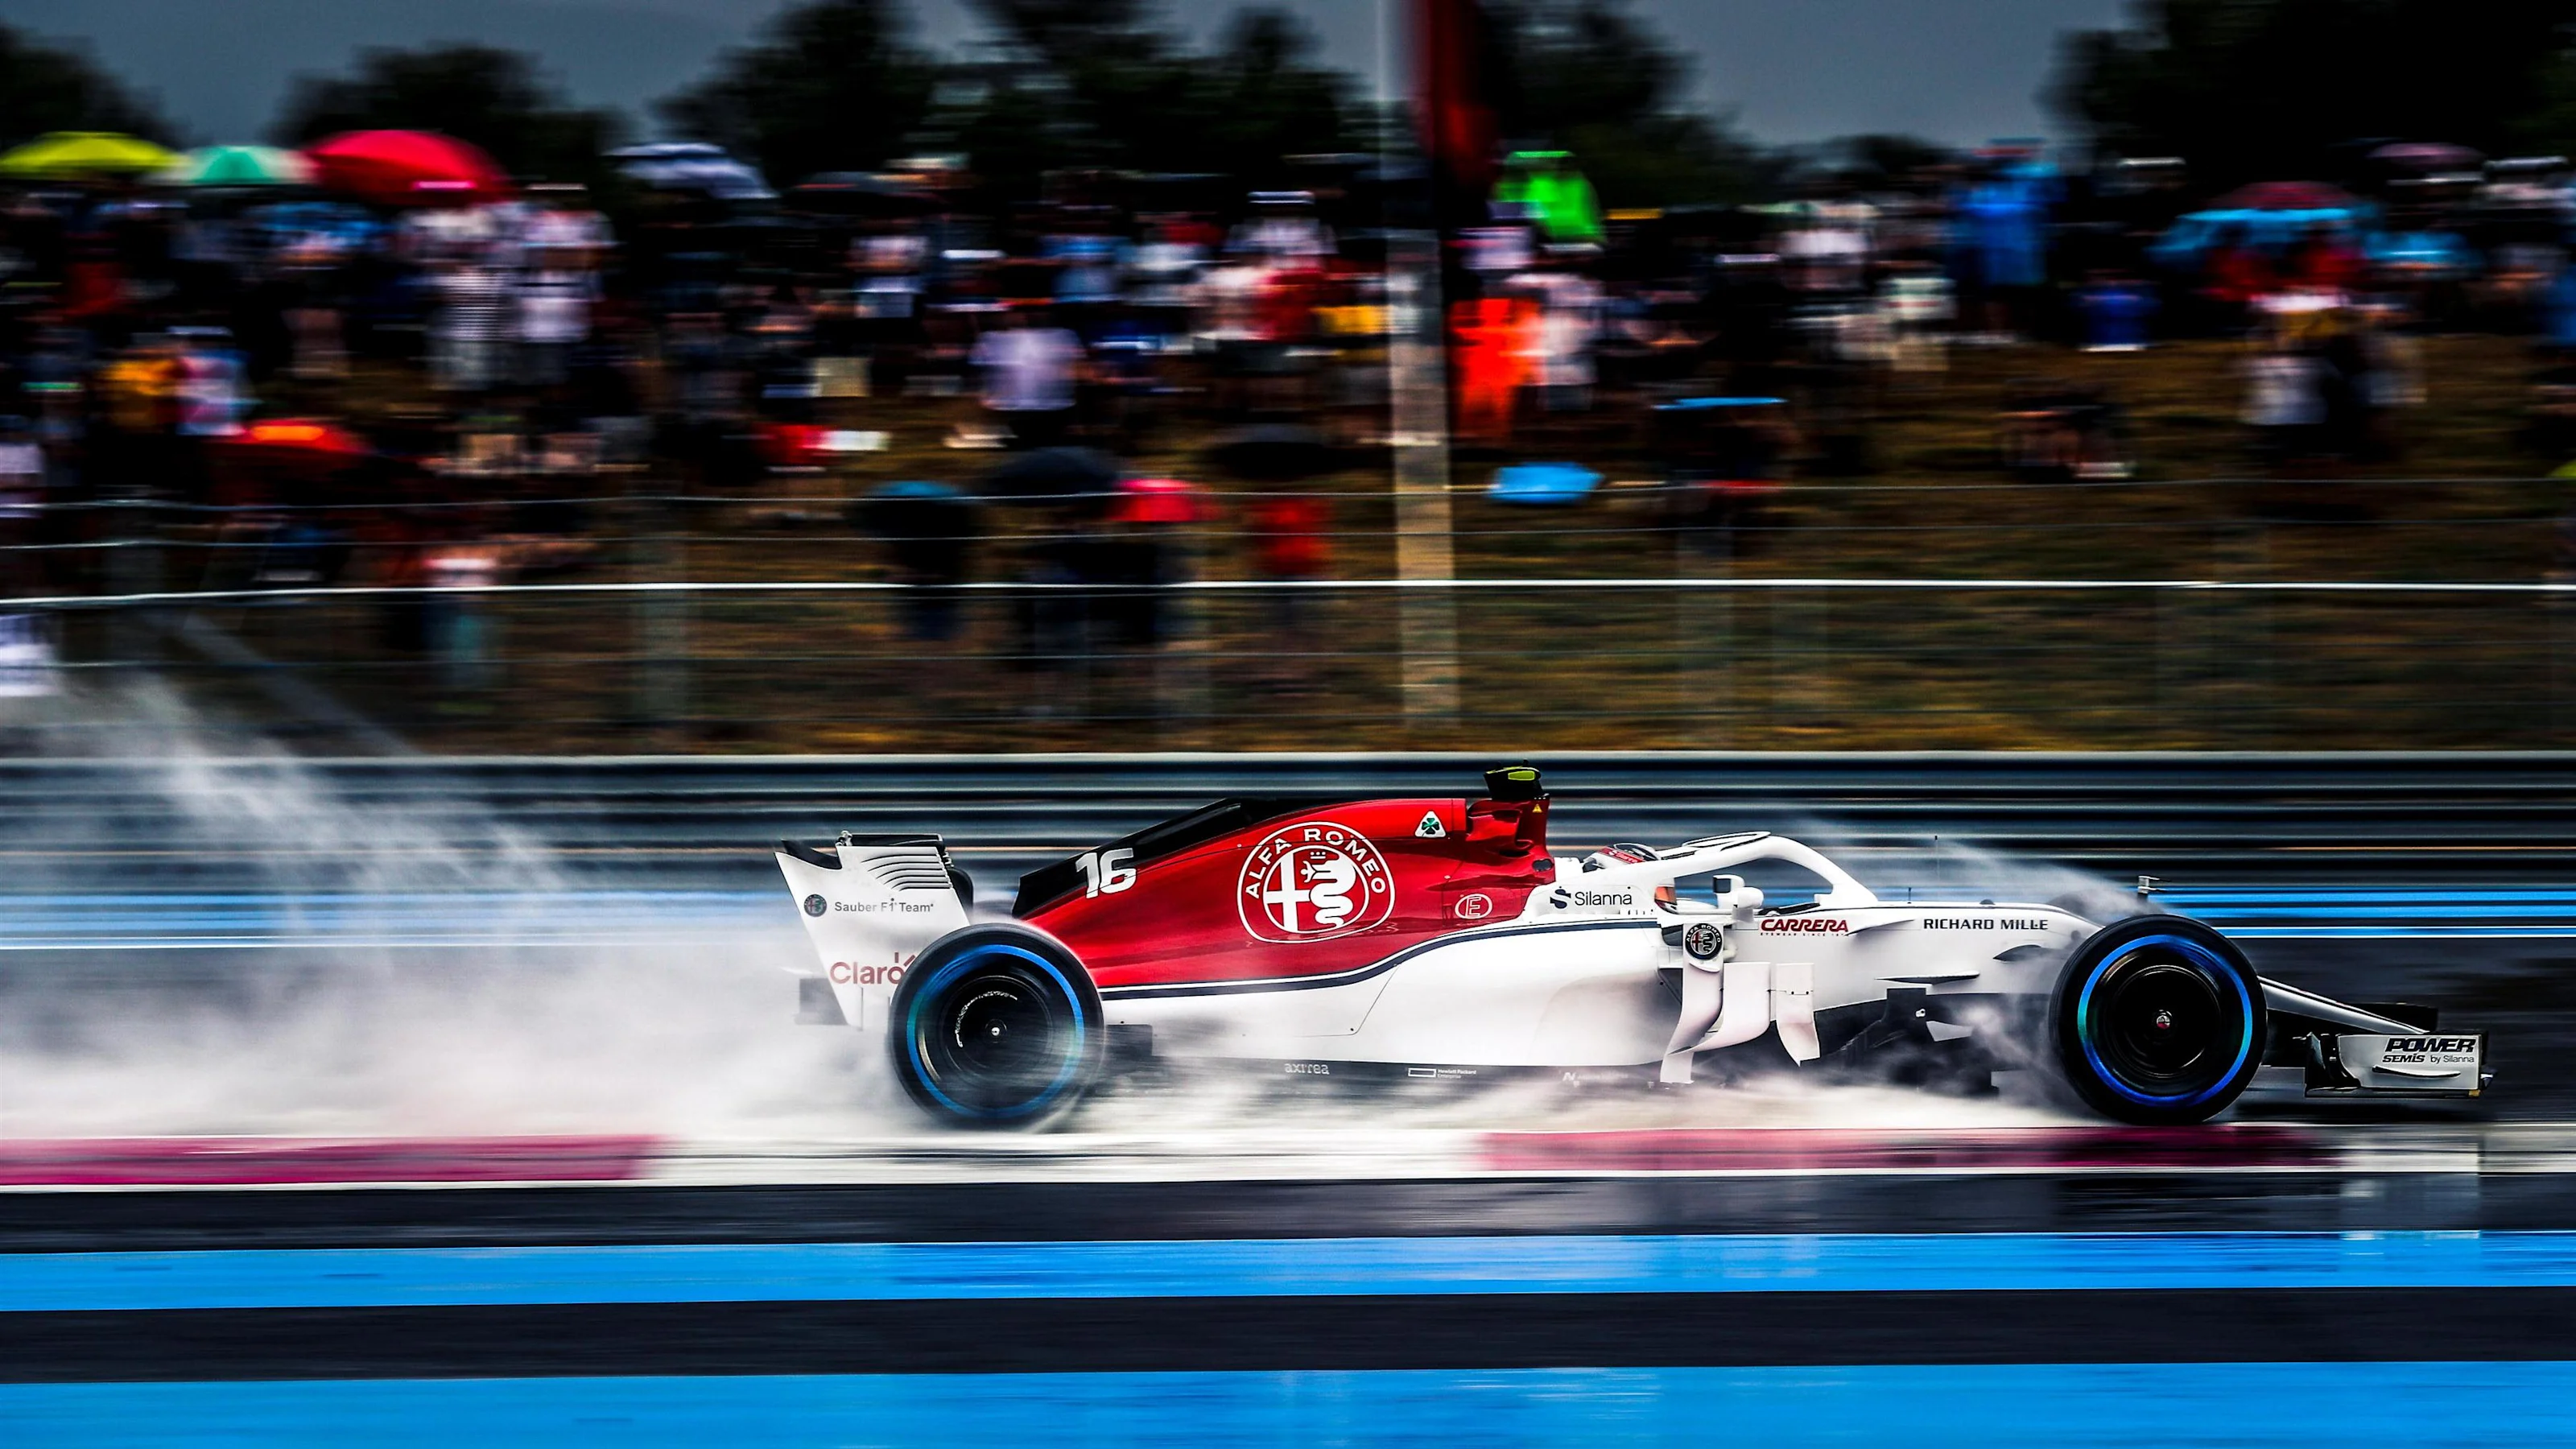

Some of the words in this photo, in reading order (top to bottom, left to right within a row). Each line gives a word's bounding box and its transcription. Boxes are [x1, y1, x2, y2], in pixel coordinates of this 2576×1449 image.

[1245, 838, 1292, 898] ALFA
[1303, 828, 1386, 894] ROMEO
[1075, 848, 1137, 898] 16
[1575, 891, 1633, 906] Silanna
[835, 902, 877, 912] Sauber
[898, 902, 931, 912] Team
[1465, 897, 1481, 918] E
[1761, 919, 1849, 932] CARRERA
[1923, 919, 1994, 930] RICHARD
[2000, 919, 2049, 930] MILLE
[1686, 927, 1699, 943] ALFA
[1701, 924, 1721, 943] ROMEO
[830, 959, 906, 985] Claro
[2384, 1038, 2476, 1053] POWER
[2430, 1055, 2441, 1065] by
[2443, 1055, 2475, 1063] Silanna
